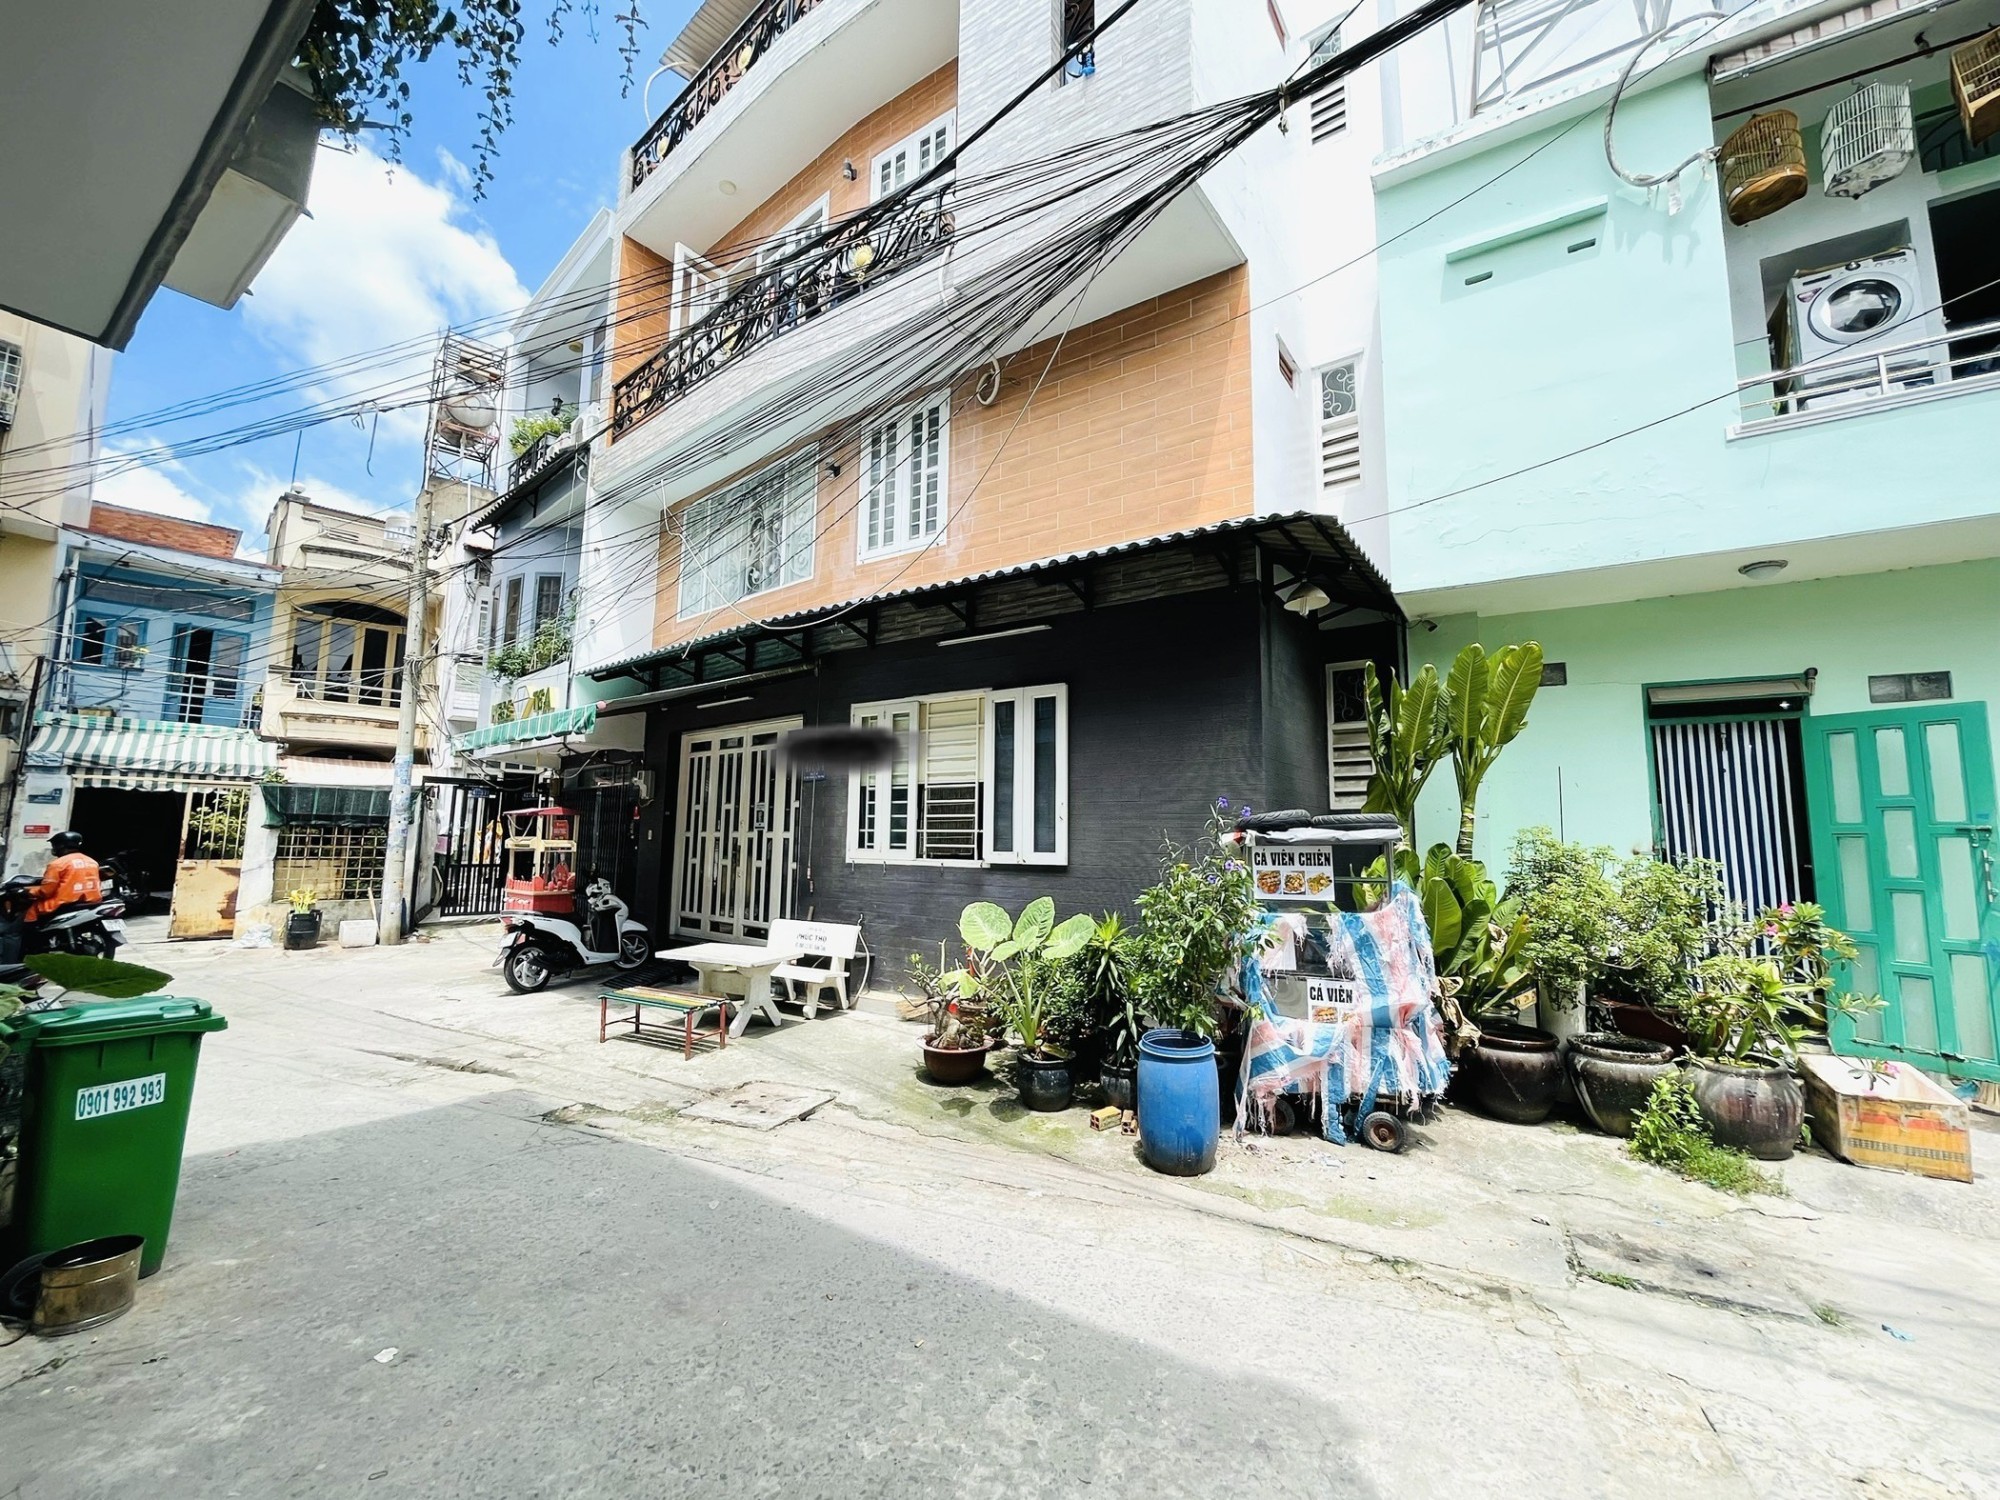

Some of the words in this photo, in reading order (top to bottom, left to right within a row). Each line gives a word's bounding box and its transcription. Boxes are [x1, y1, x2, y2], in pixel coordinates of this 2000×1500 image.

[1254, 848, 1267, 866] CÁ
[1270, 848, 1295, 866] VIÊN
[1298, 848, 1331, 866] CHIÊN
[1310, 983, 1323, 1001] CÁ
[1327, 985, 1353, 1003] VIÊN
[78, 1088, 109, 1117] 0901
[114, 1084, 136, 1110] 992
[140, 1079, 162, 1104] 993
